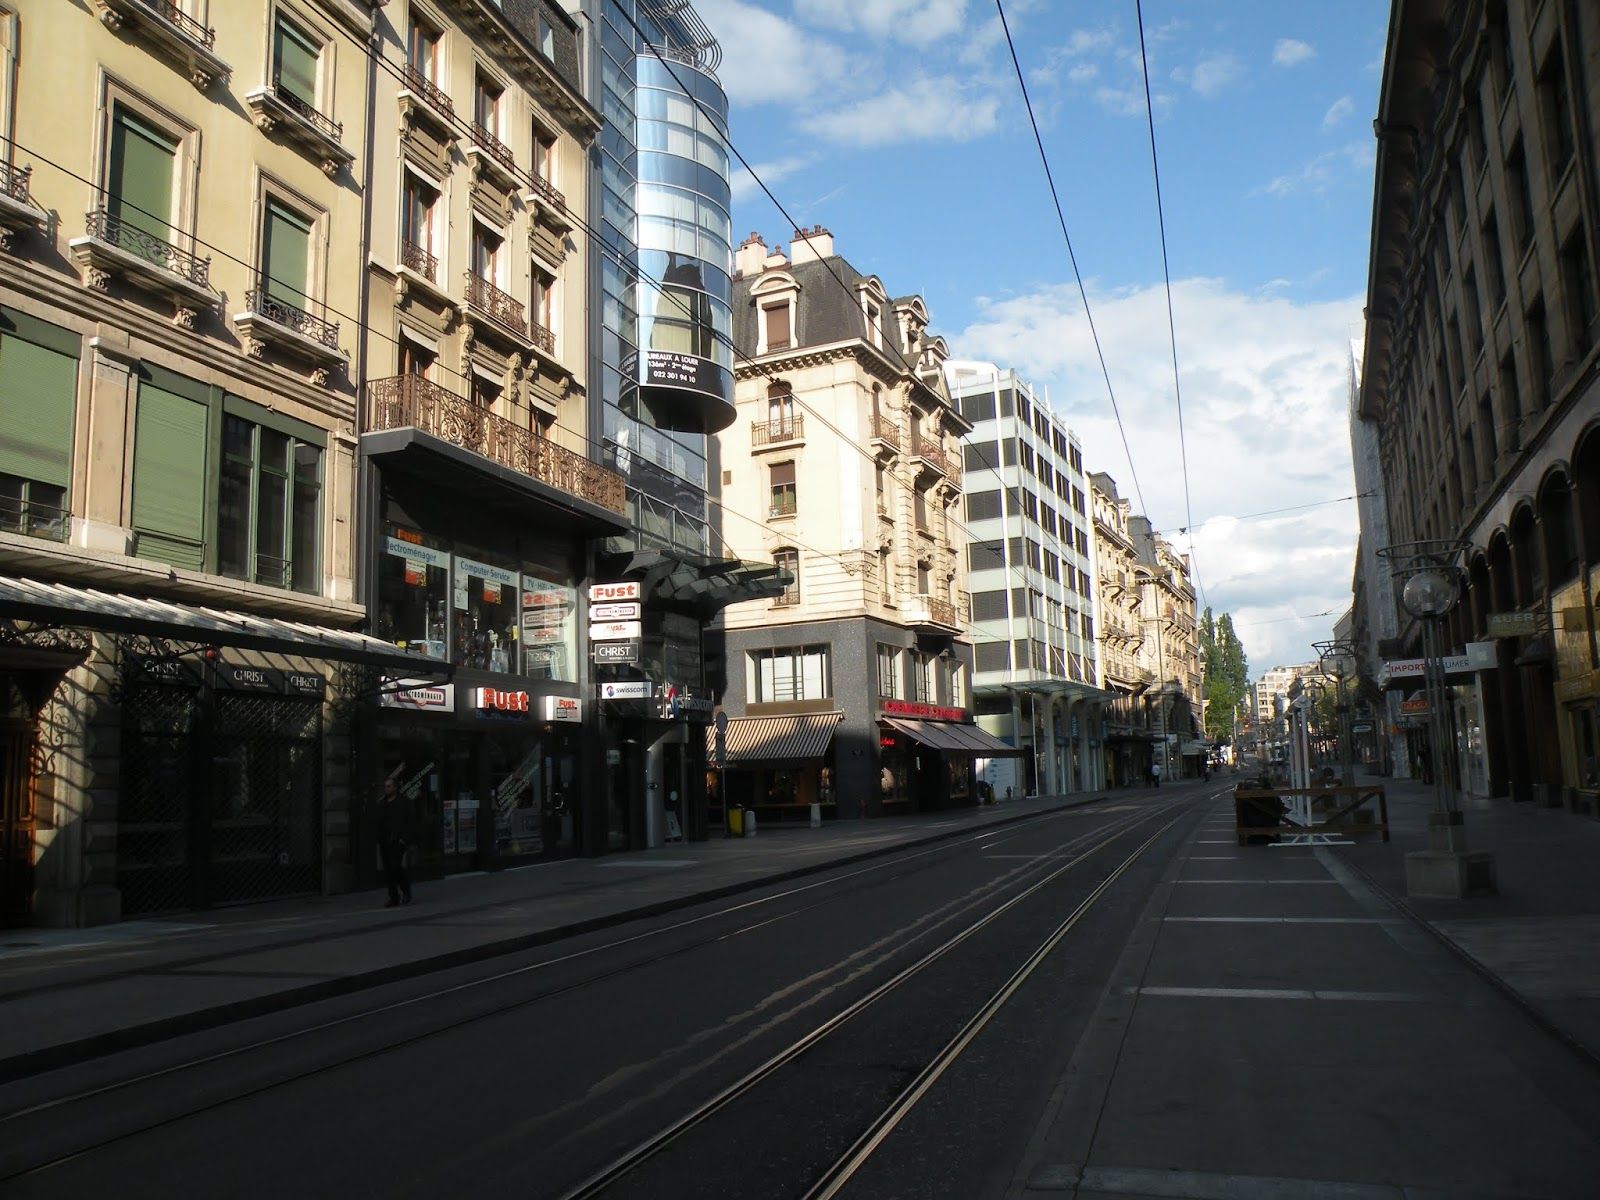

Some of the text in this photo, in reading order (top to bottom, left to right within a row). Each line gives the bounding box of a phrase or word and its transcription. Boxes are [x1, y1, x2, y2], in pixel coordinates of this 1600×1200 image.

[646, 353, 673, 361] UREAUX
[682, 356, 699, 366] LOUER
[654, 370, 696, 383] 022 301 94 10
[594, 585, 636, 599] Fust
[599, 646, 631, 657] CHRIST
[144, 660, 182, 677] CHRIST
[1391, 663, 1426, 673] IMPORT
[233, 670, 265, 683] CHRIST
[290, 675, 319, 688] CHRIST
[616, 685, 648, 694] swisscom
[483, 687, 529, 712] Fust
